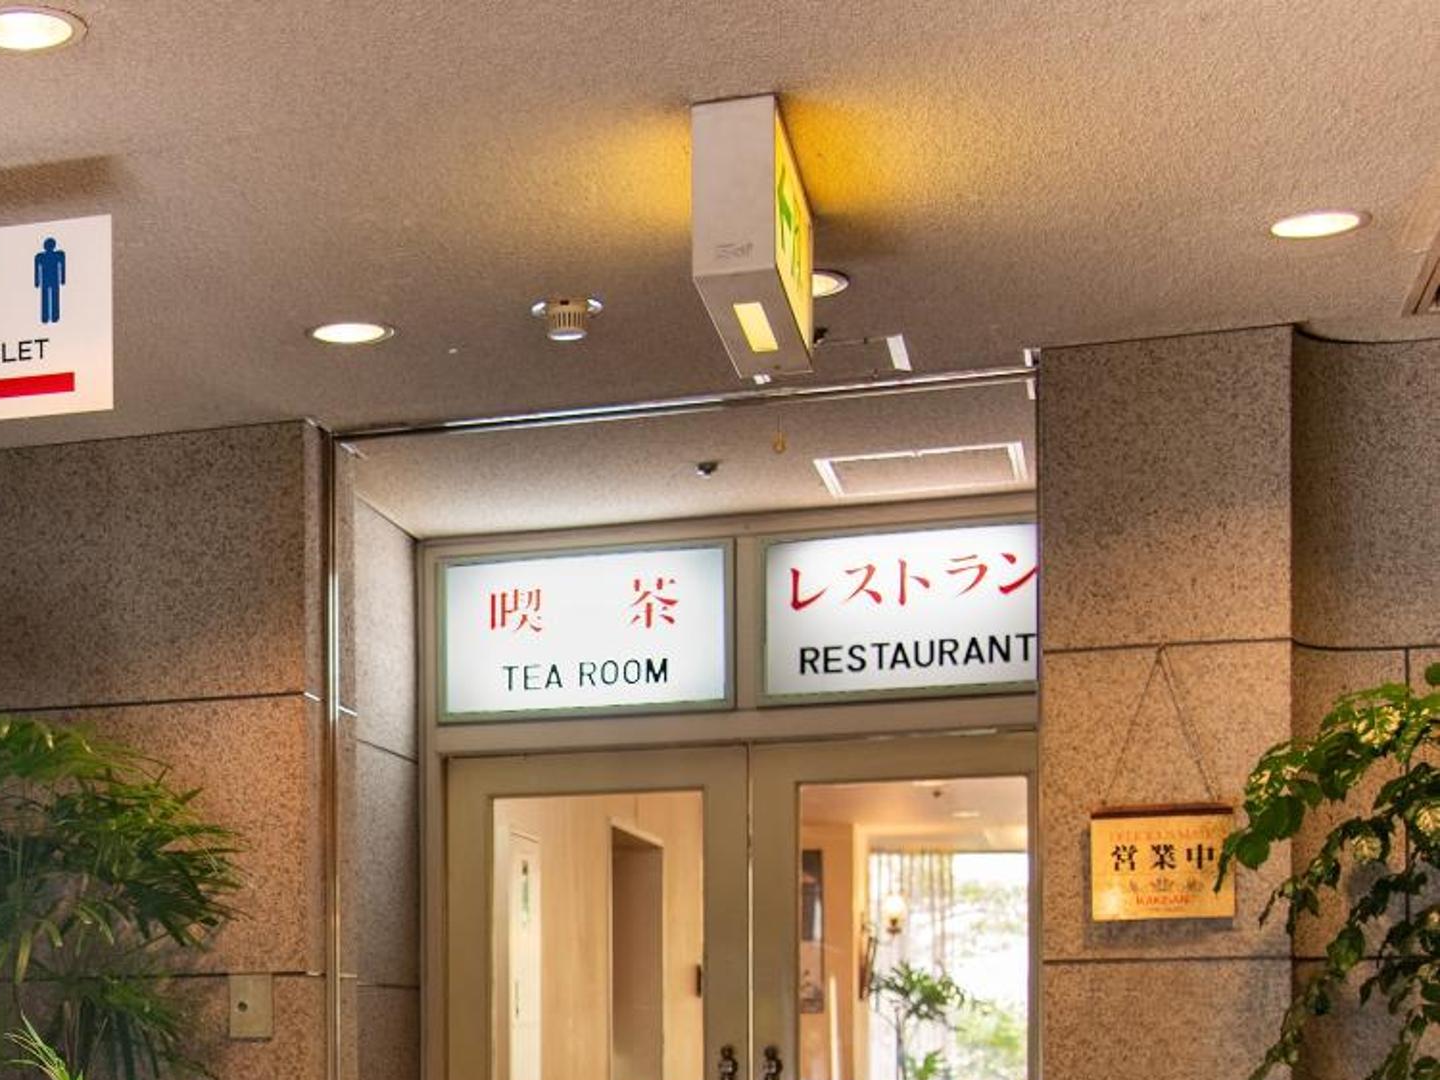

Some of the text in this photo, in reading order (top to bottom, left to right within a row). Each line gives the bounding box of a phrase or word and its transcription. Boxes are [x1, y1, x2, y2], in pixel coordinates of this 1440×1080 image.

[790, 551, 1038, 611] レストラン
[799, 632, 1035, 675] RESTAURANT
[503, 658, 669, 692] TEA ROOM
[1112, 844, 1214, 871] 営業中
